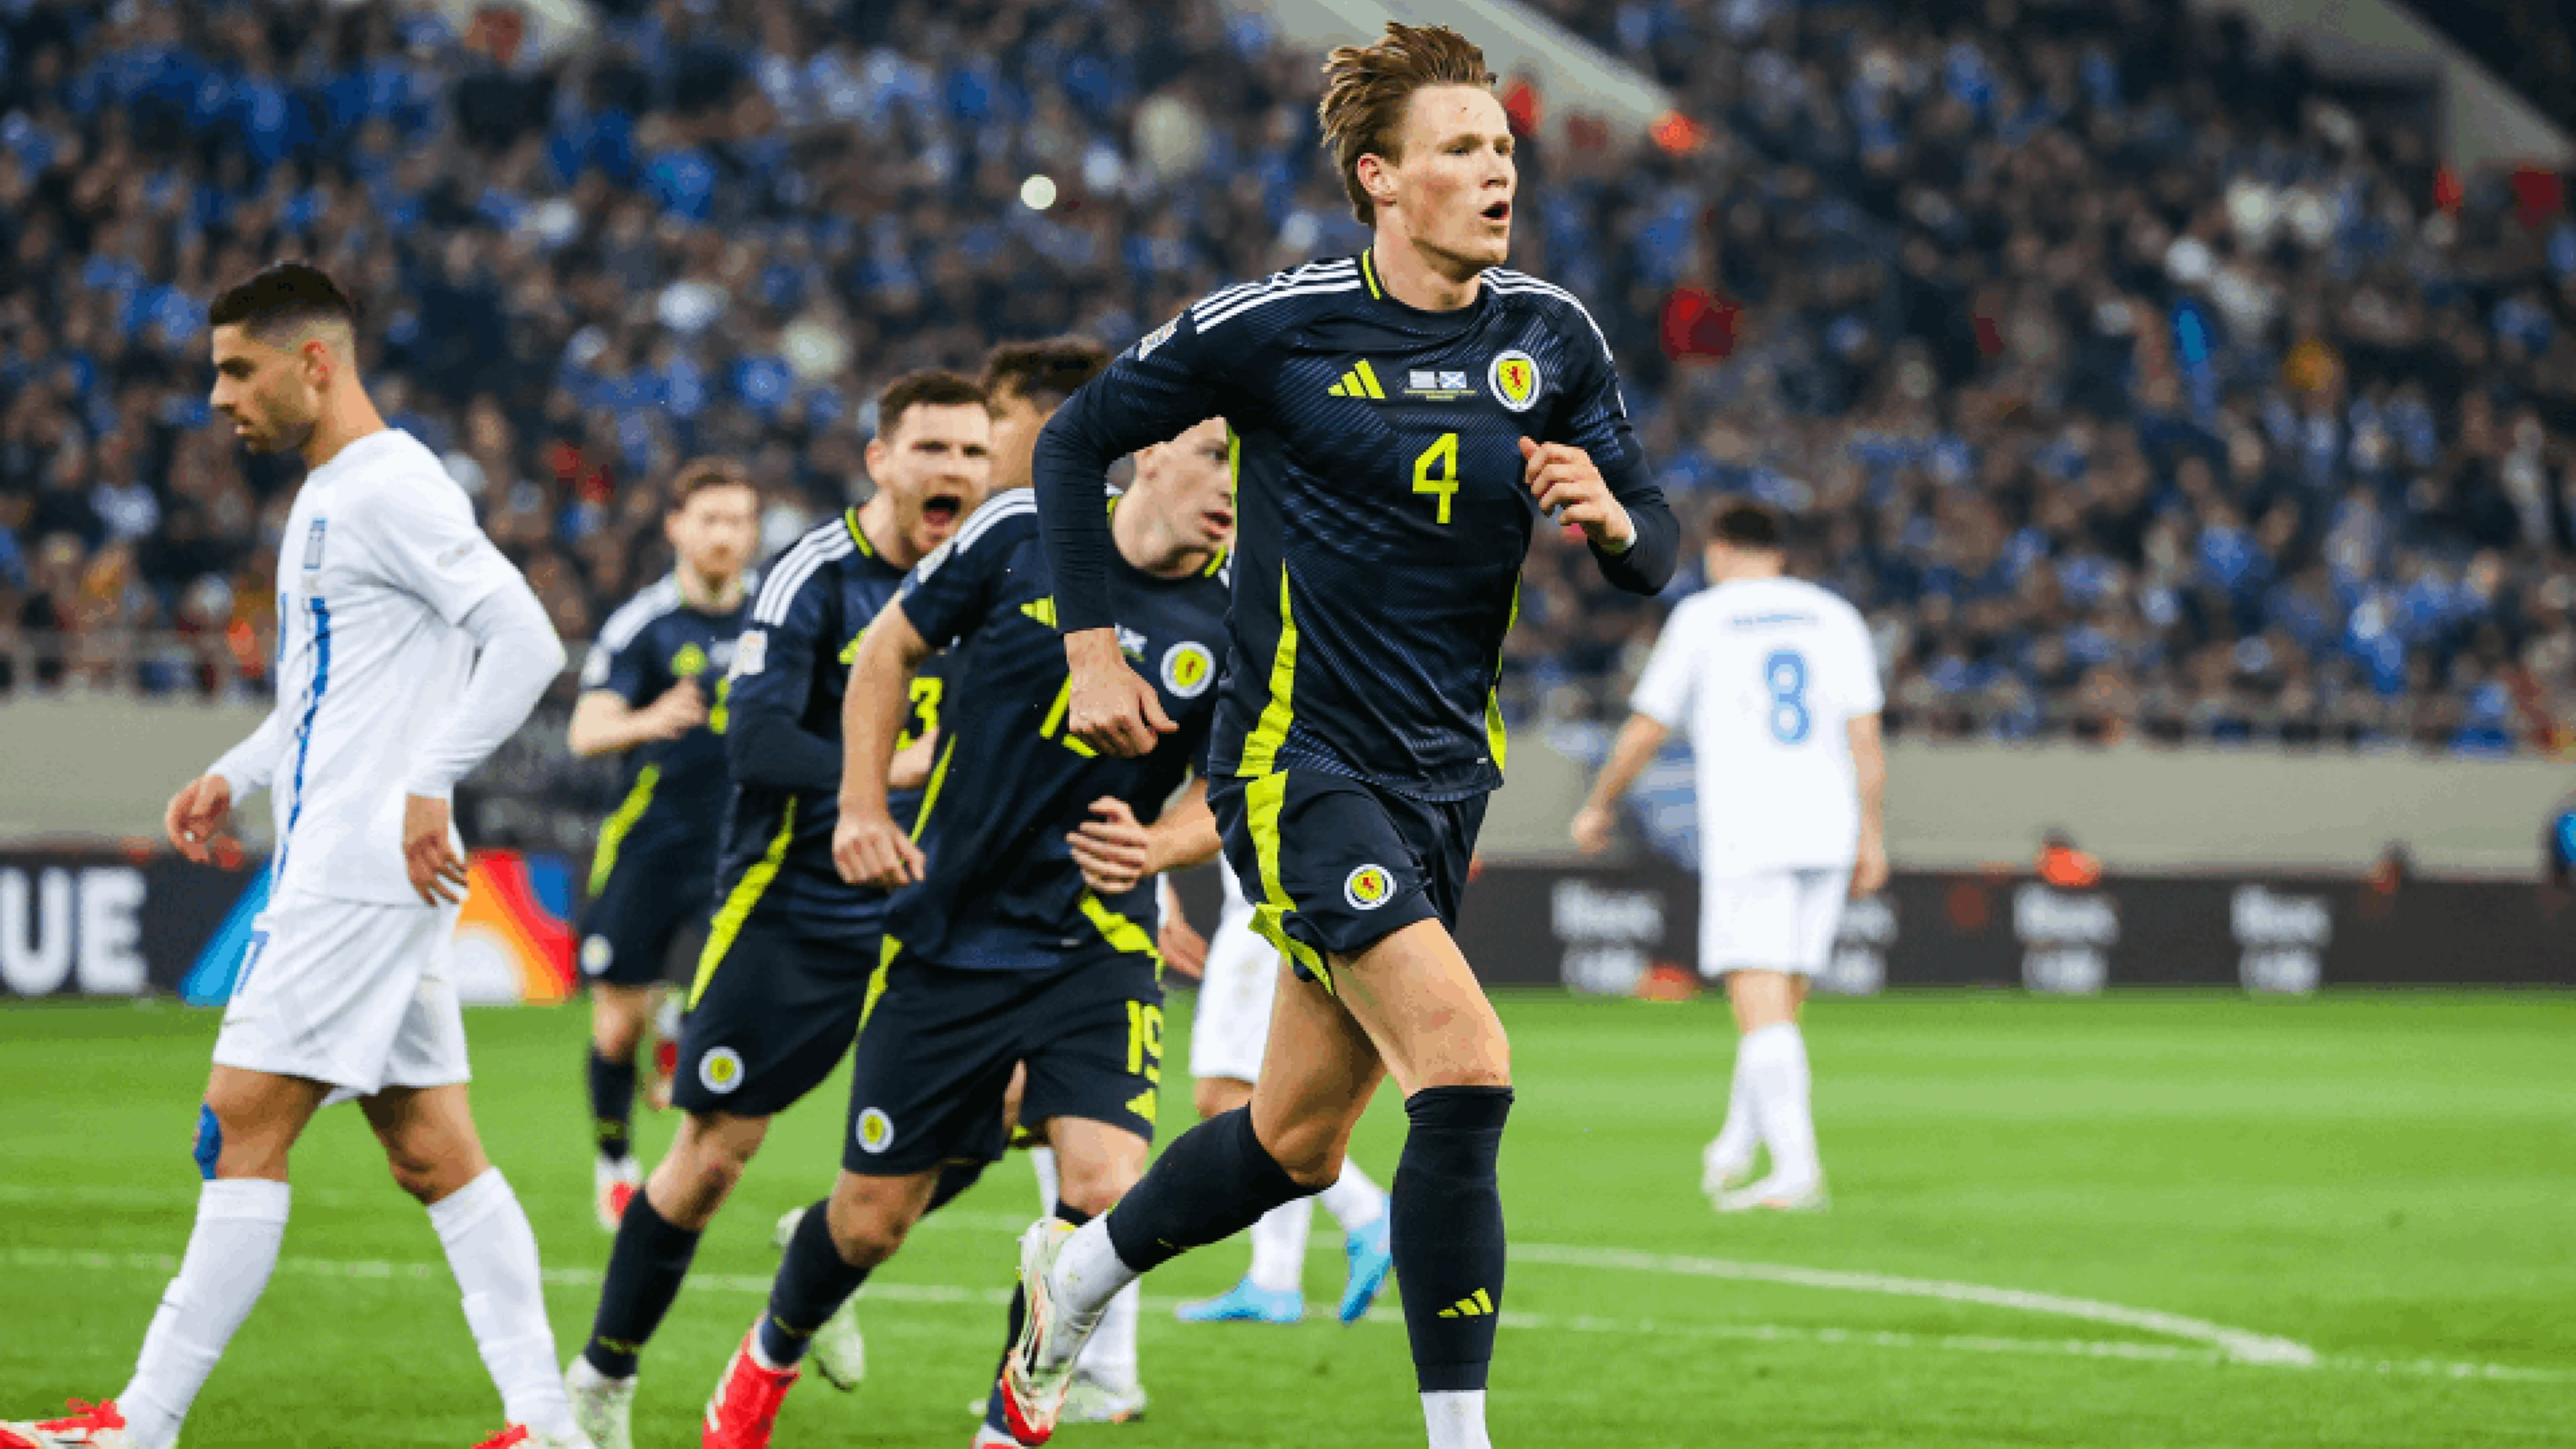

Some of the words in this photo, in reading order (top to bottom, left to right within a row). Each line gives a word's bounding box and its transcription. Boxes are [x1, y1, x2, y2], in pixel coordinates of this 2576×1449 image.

[1412, 433, 1459, 524] 4
[1763, 649, 1812, 745] 8
[0, 866, 148, 996] UE
